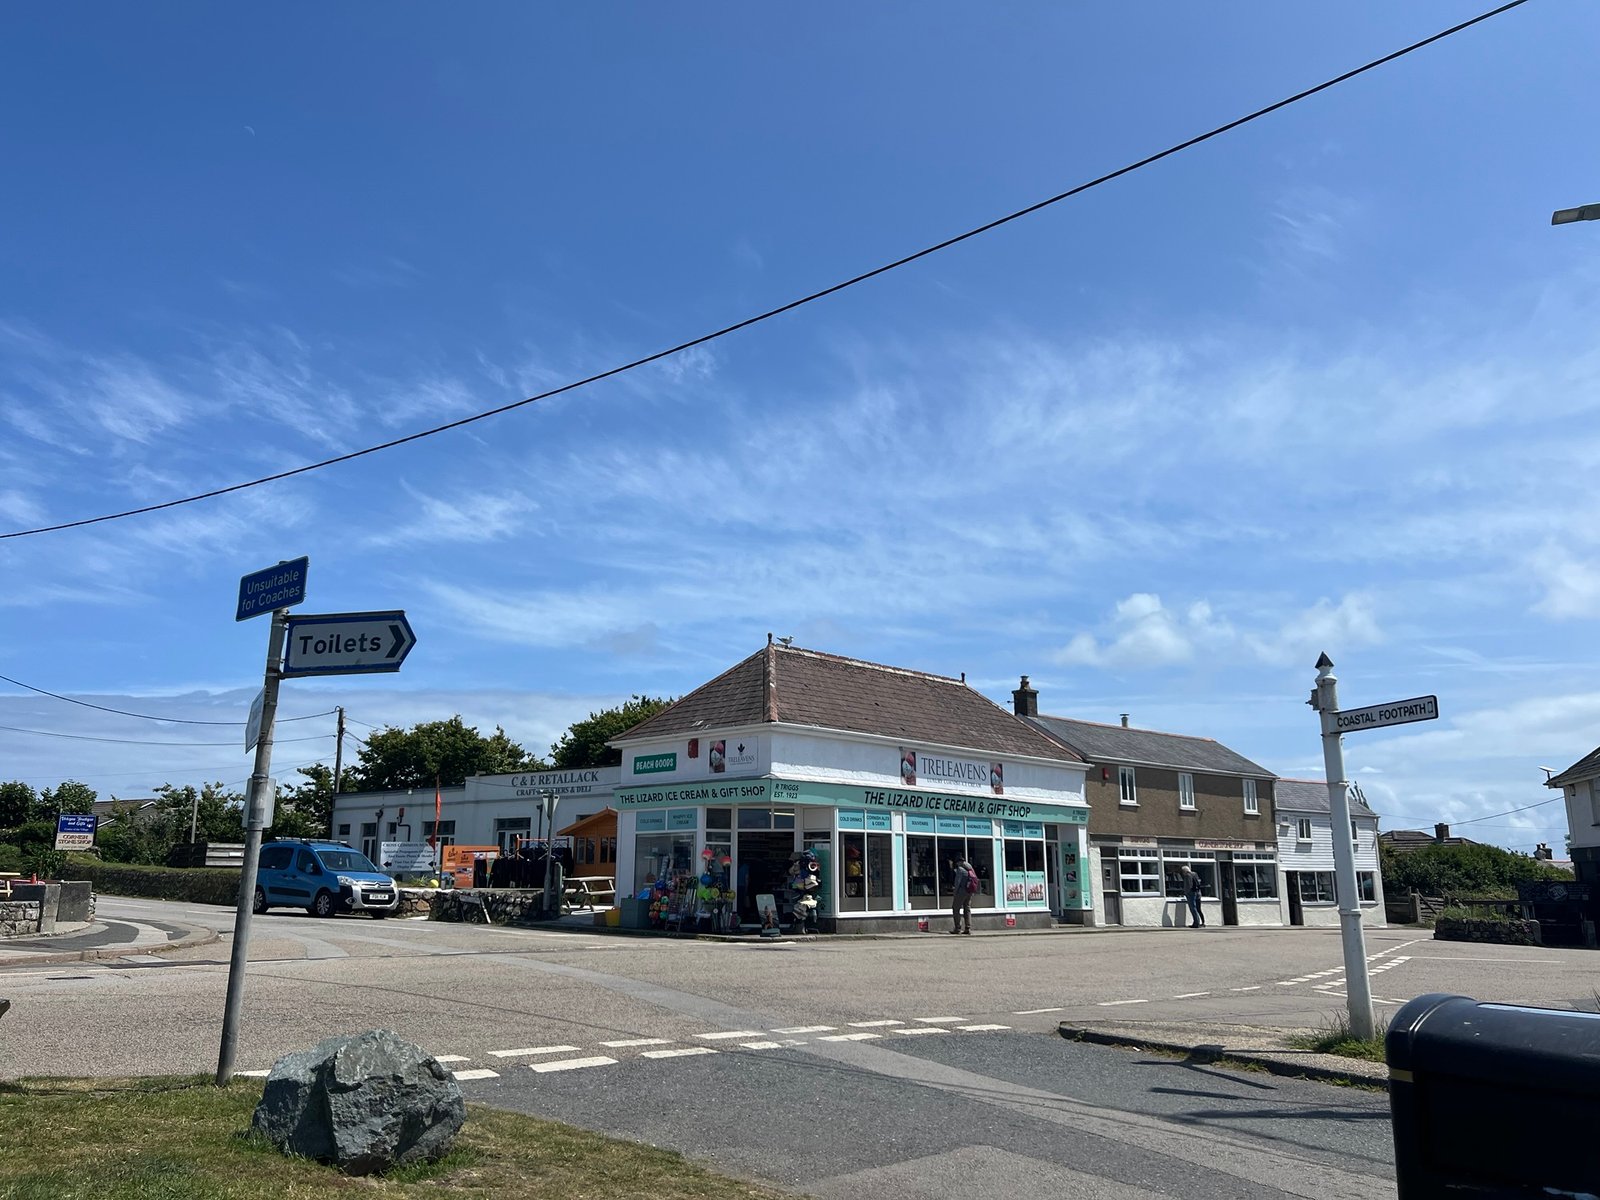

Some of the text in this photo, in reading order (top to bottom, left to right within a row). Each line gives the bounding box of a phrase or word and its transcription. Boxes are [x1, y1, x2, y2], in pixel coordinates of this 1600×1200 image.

[247, 569, 299, 595] Unsuitable
[241, 585, 300, 612] for Coaches
[299, 632, 381, 655] Toilets
[1337, 703, 1426, 728] COASTAL FOOTPATH
[636, 758, 674, 770] BEACH GOODS
[921, 757, 987, 781] TRELEAVENS
[511, 771, 599, 787] C & E RETALLACK
[780, 783, 799, 791] TRIGGS
[516, 788, 536, 796] CRAFT
[576, 785, 592, 793] DELI
[620, 785, 765, 804] THE LIZARD ICE CREAM & GIFT SHOP
[774, 791, 785, 799] EST.
[864, 790, 1031, 819] THE LIZARD ICE CREAM & GIFT SHOP
